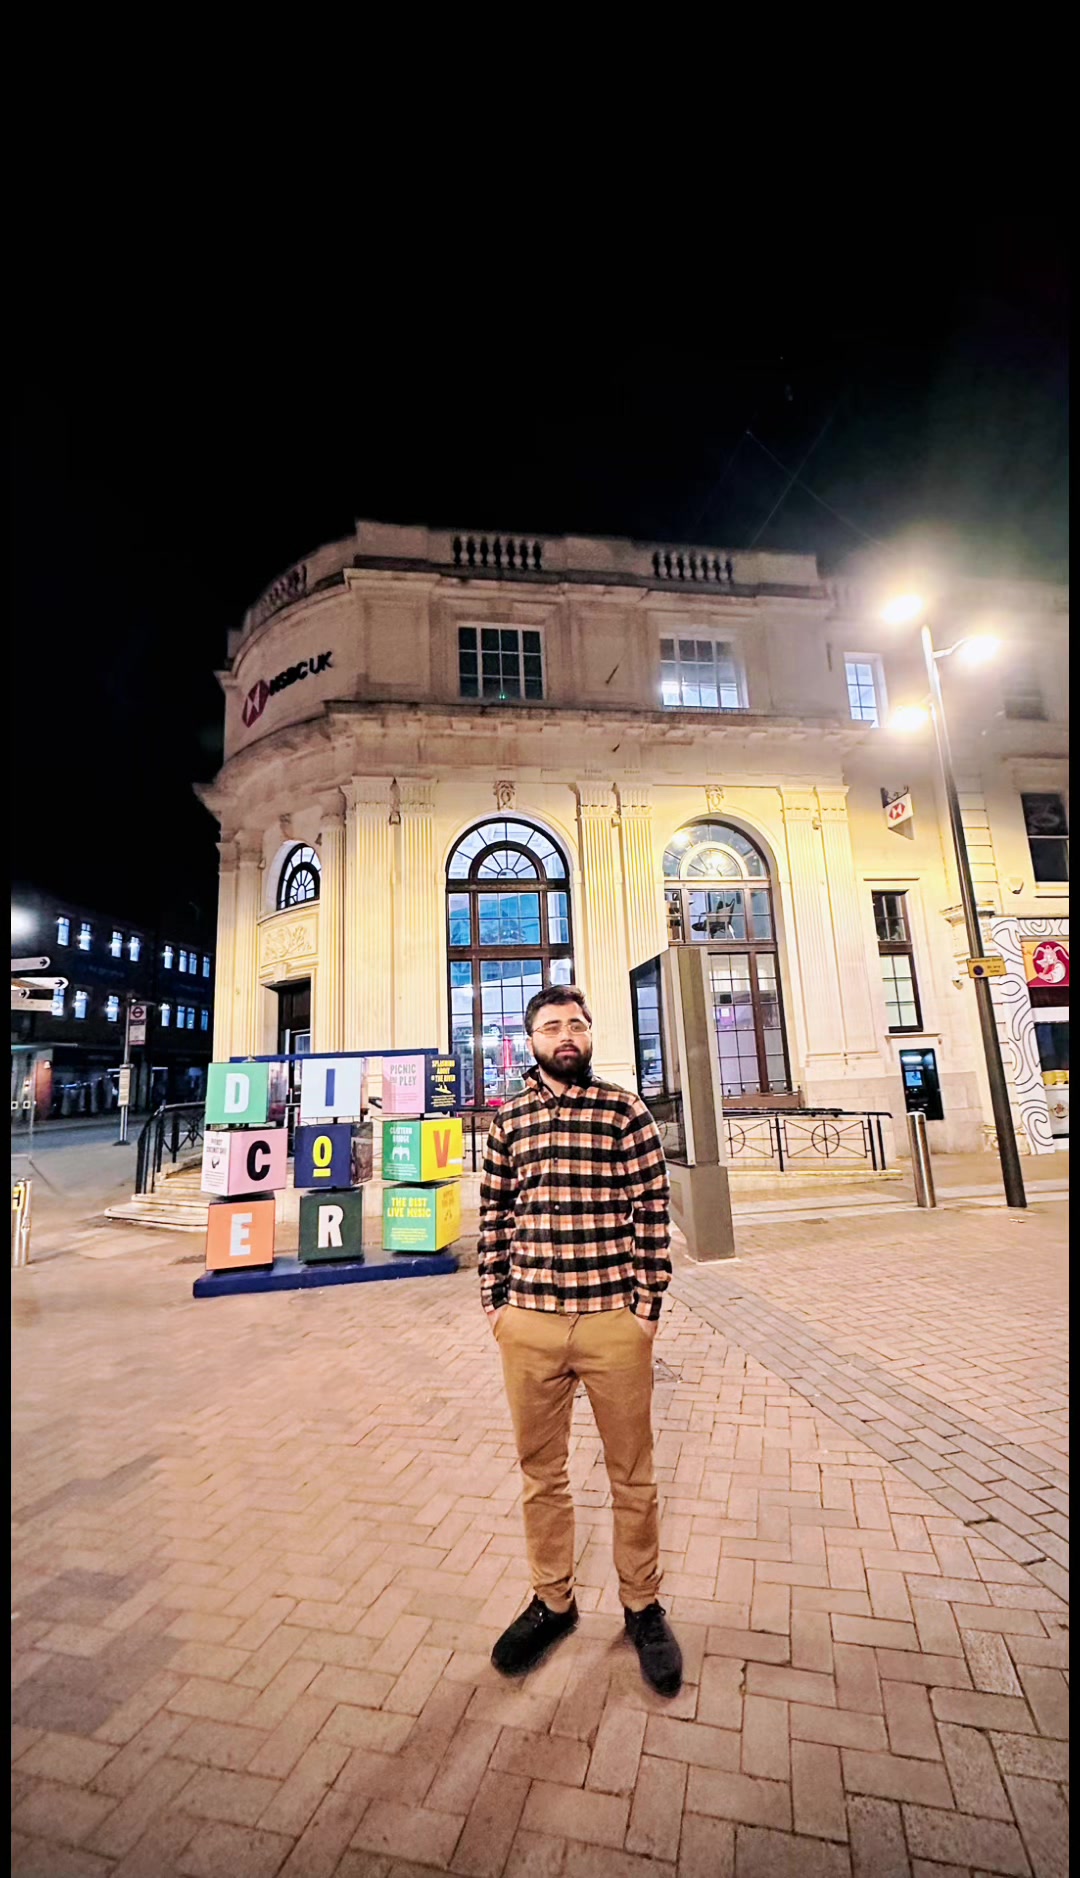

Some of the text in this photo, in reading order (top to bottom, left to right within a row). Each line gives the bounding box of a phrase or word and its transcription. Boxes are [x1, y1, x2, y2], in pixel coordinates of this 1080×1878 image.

[269, 651, 333, 696] HSBC UK
[224, 1068, 336, 1114] D I
[390, 1064, 417, 1075] PICNIC
[246, 1140, 271, 1181] C
[312, 1135, 333, 1169] O
[433, 1129, 451, 1168] V
[229, 1205, 344, 1257] E R
[387, 1207, 405, 1217] LIVE
